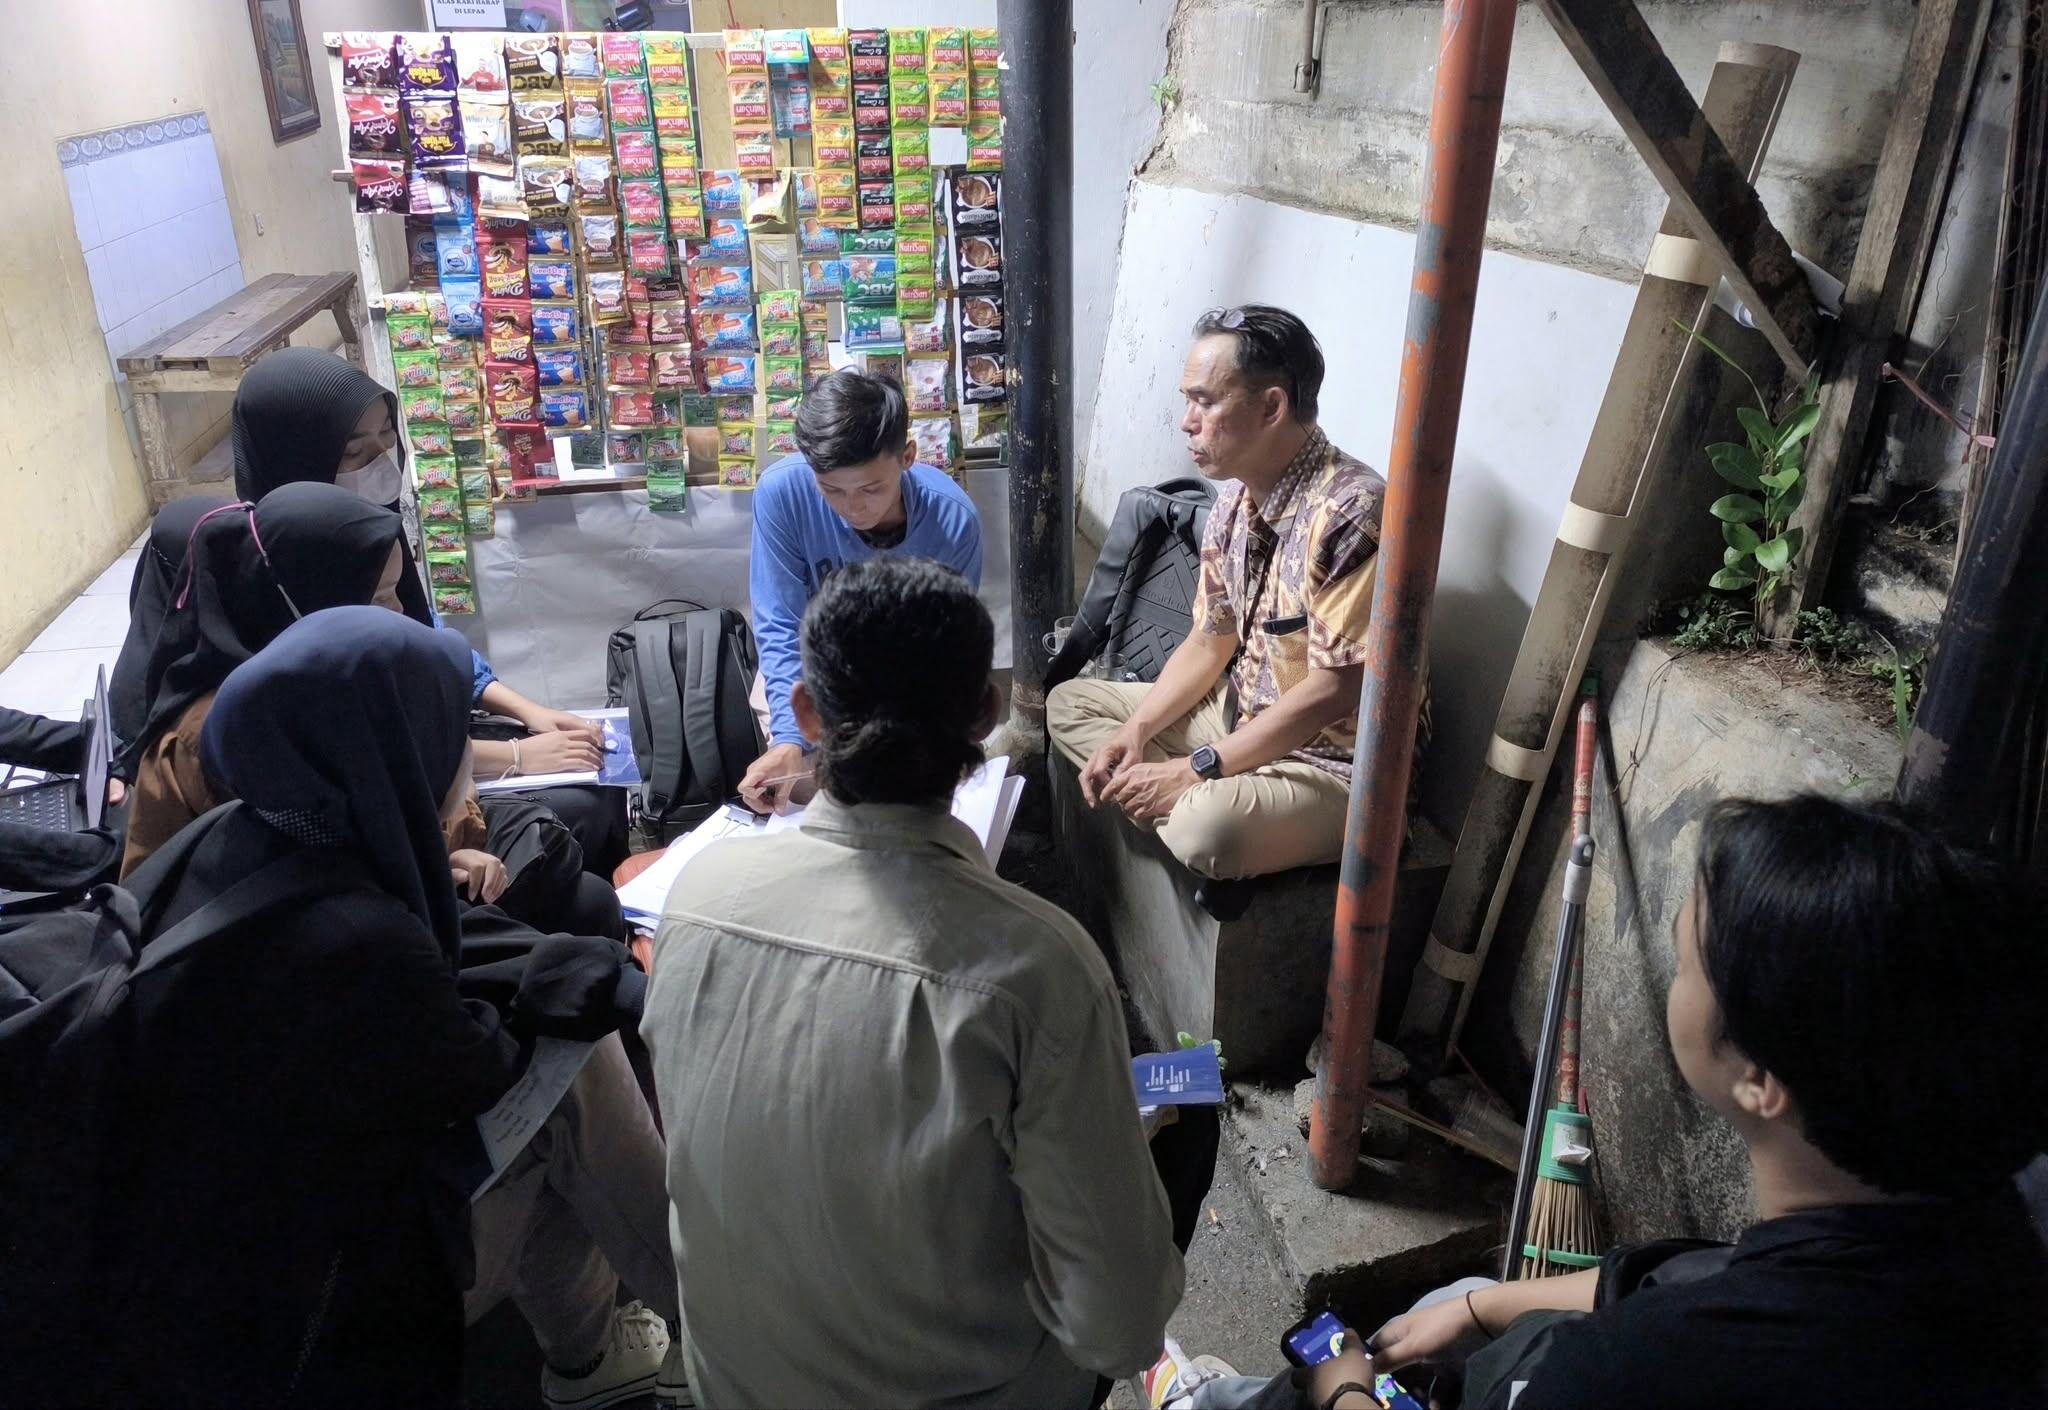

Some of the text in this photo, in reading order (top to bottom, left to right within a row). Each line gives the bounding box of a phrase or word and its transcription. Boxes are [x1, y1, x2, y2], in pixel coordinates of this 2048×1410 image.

[512, 76, 554, 89] ABC
[523, 143, 562, 155] ABC
[531, 206, 569, 218] ABC
[855, 238, 893, 250] ABC
[858, 283, 895, 295] ABC
